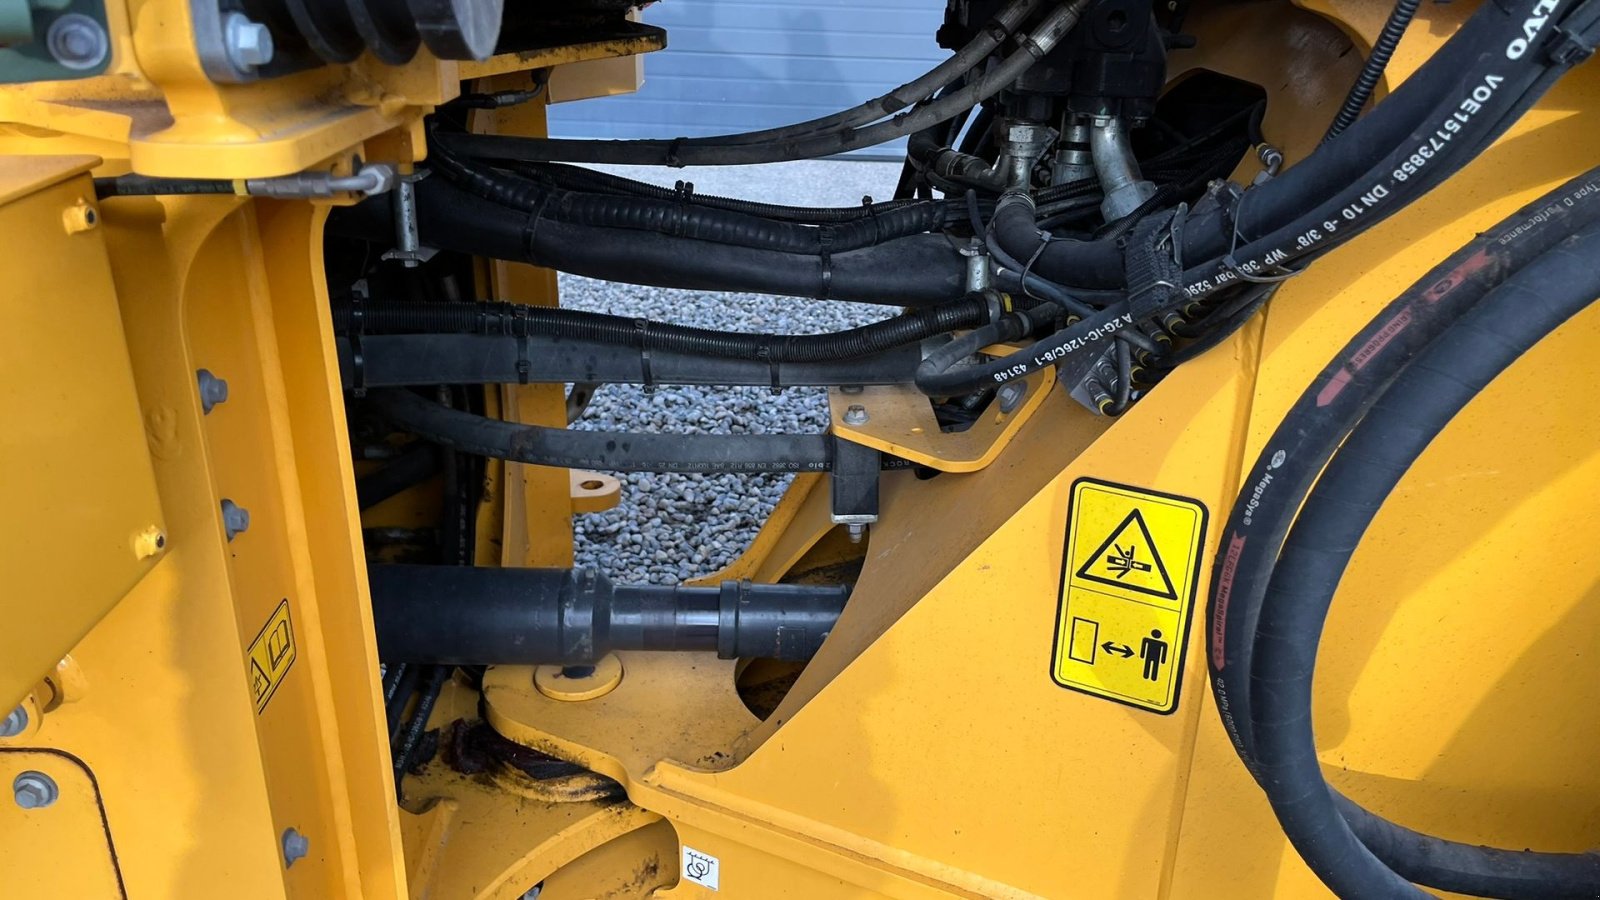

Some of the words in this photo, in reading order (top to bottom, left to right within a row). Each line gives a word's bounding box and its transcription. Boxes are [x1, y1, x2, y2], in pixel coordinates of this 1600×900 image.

[1393, 73, 1504, 182] VOE15173858
[1360, 184, 1389, 208] DN
[1342, 199, 1364, 221] 10
[1264, 249, 1288, 266] WP
[1214, 271, 1238, 284] bar
[993, 364, 1027, 383] 43148
